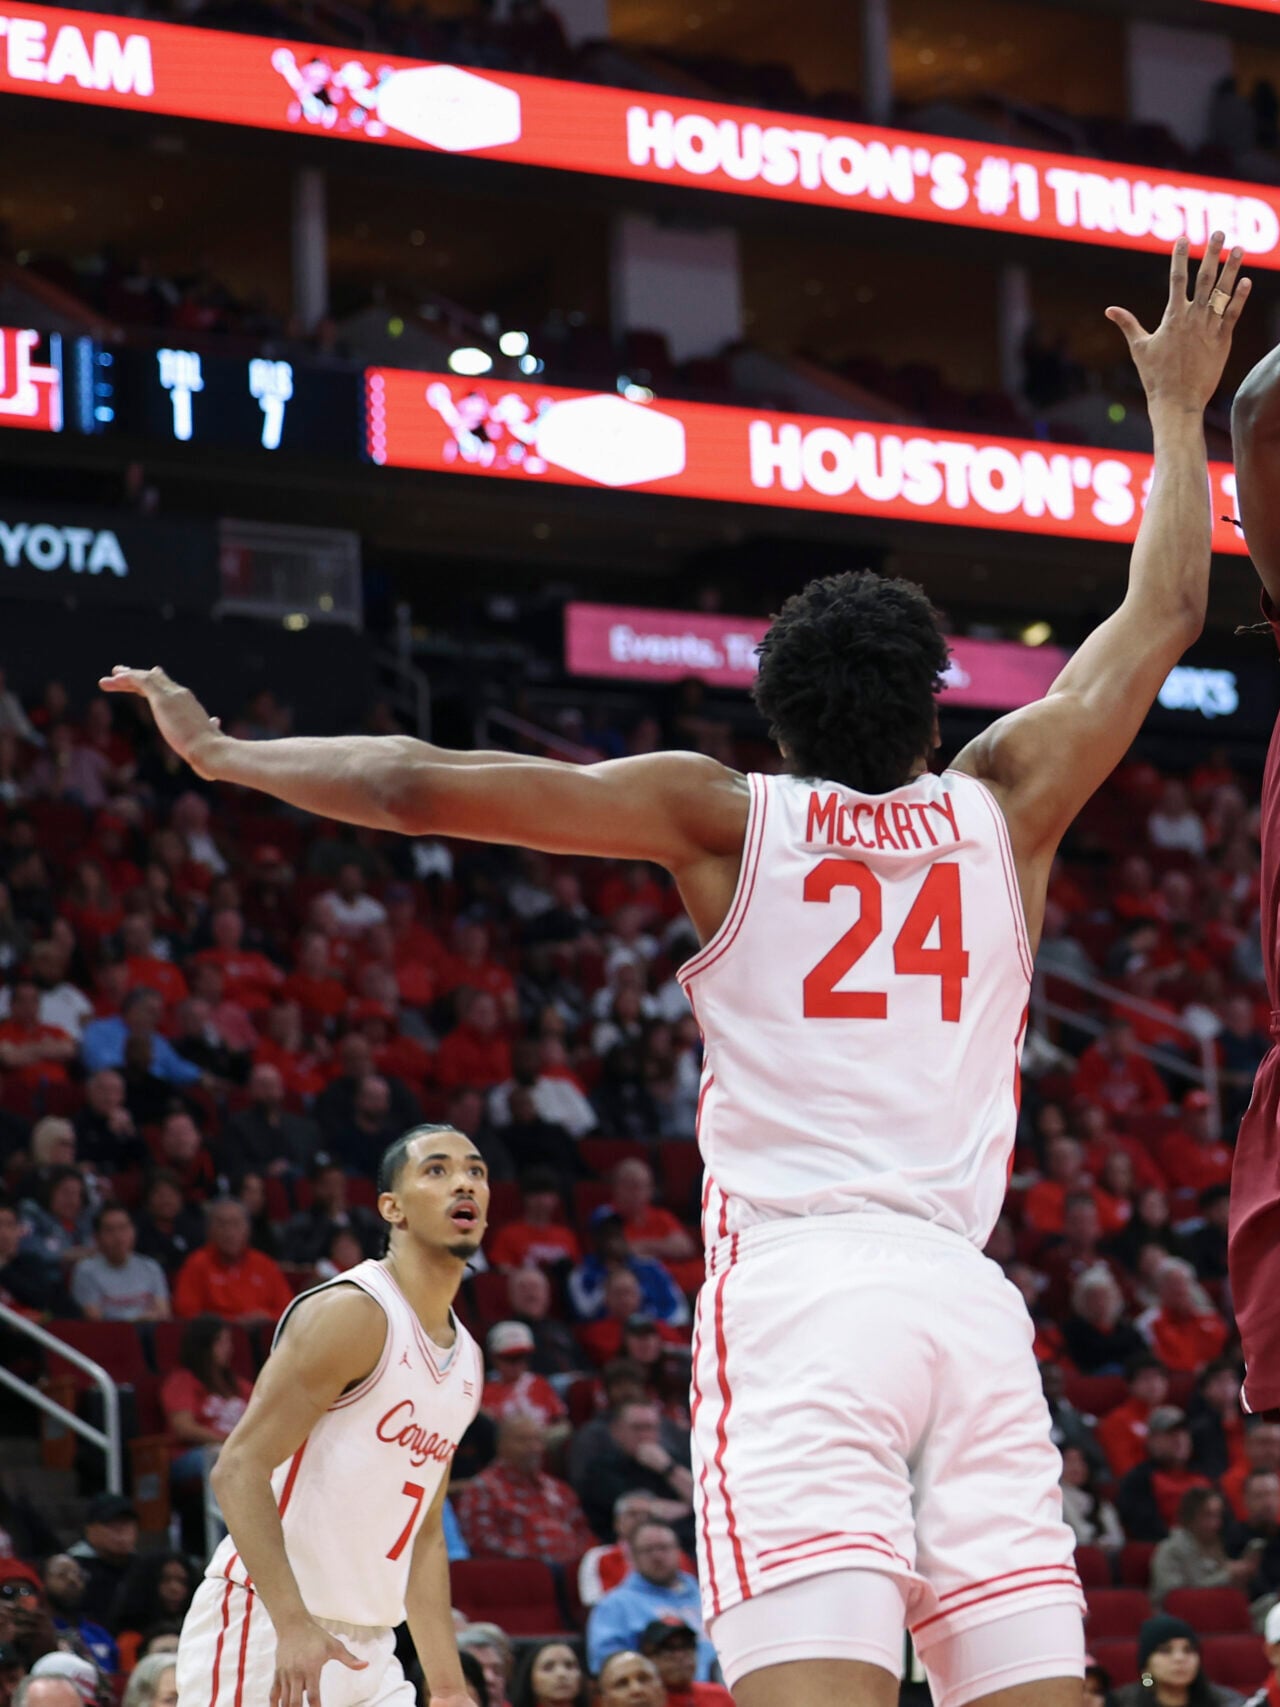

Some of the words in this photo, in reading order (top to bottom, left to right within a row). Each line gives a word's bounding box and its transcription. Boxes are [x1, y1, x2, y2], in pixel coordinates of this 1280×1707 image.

[0, 16, 155, 97] EAM
[626, 105, 969, 211] HOUSTON'S
[974, 156, 1040, 222] #1
[1045, 167, 1280, 254] TRUSTED
[748, 419, 1135, 526] HOUSTON'S
[803, 858, 970, 1023] 24
[386, 1481, 425, 1561] 7
